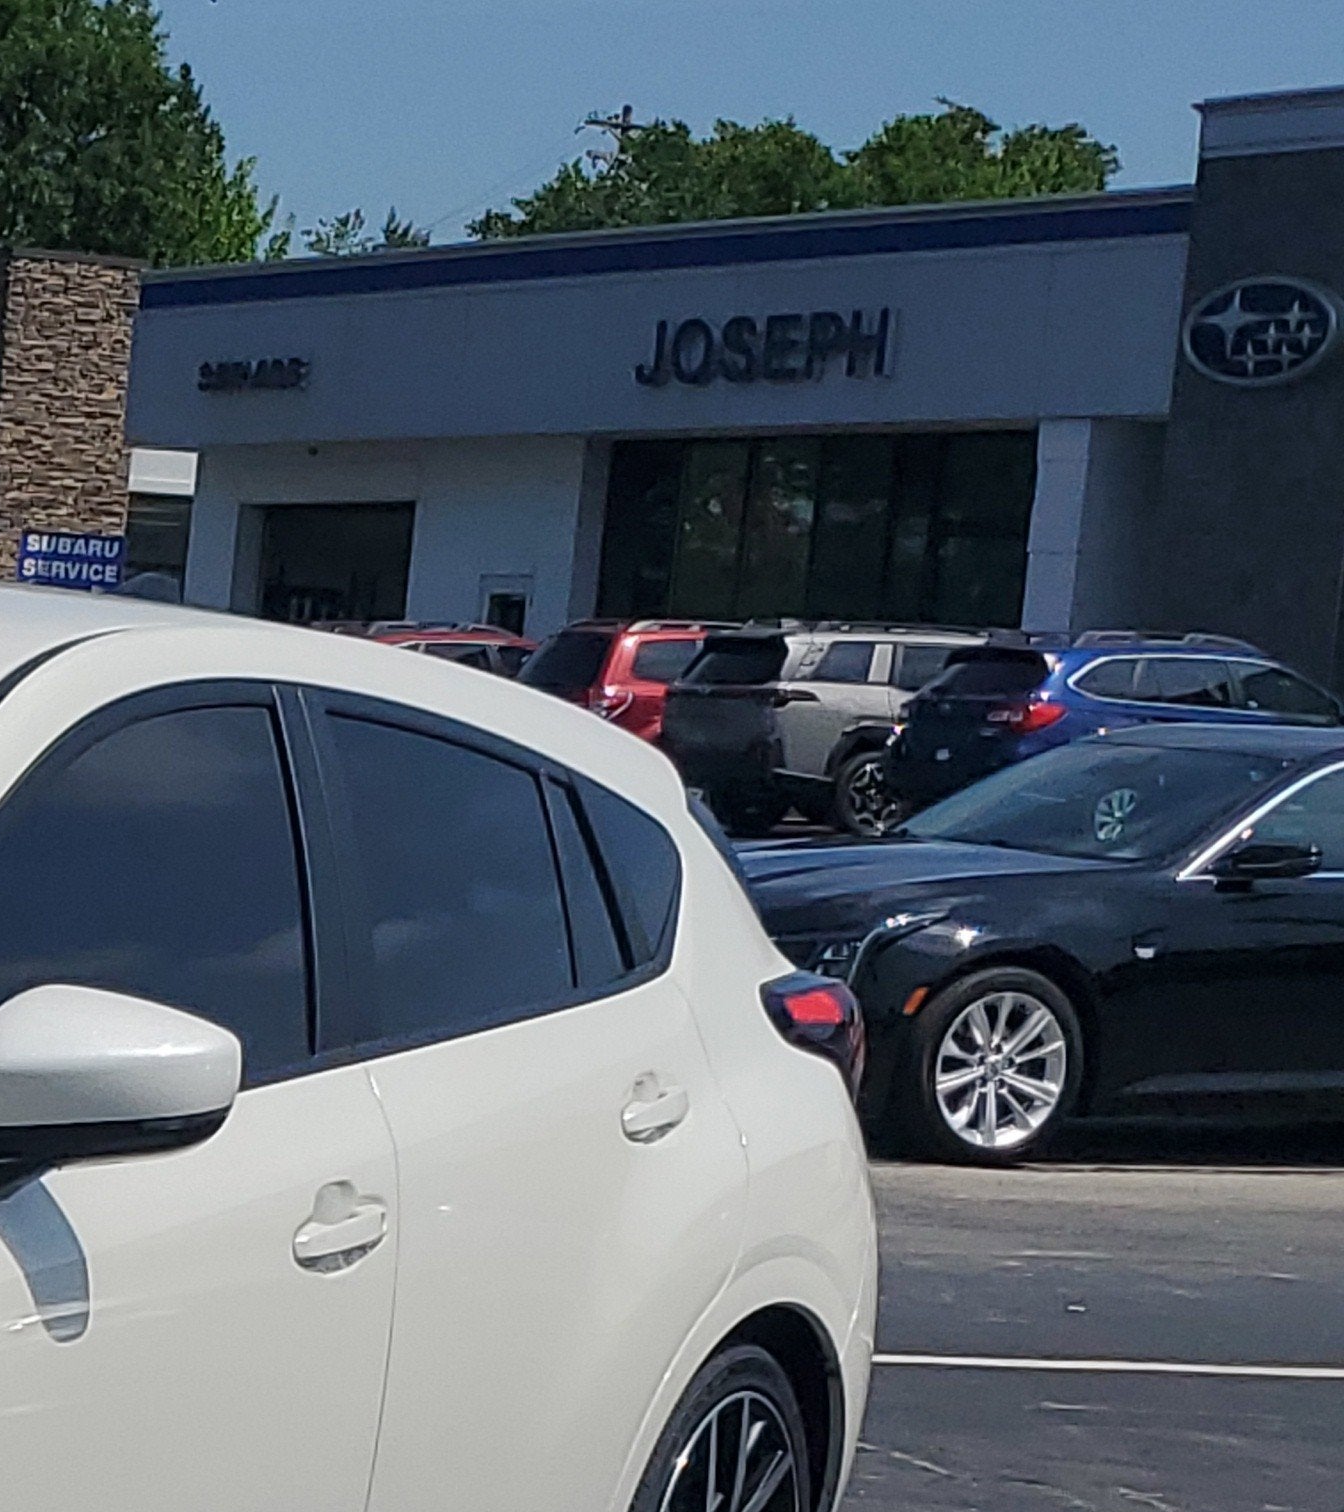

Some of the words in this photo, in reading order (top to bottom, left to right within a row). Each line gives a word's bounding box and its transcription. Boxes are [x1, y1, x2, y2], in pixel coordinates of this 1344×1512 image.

[634, 306, 892, 386] JOSEPH
[25, 533, 120, 558] SUBARU
[21, 557, 118, 583] SERVICE
